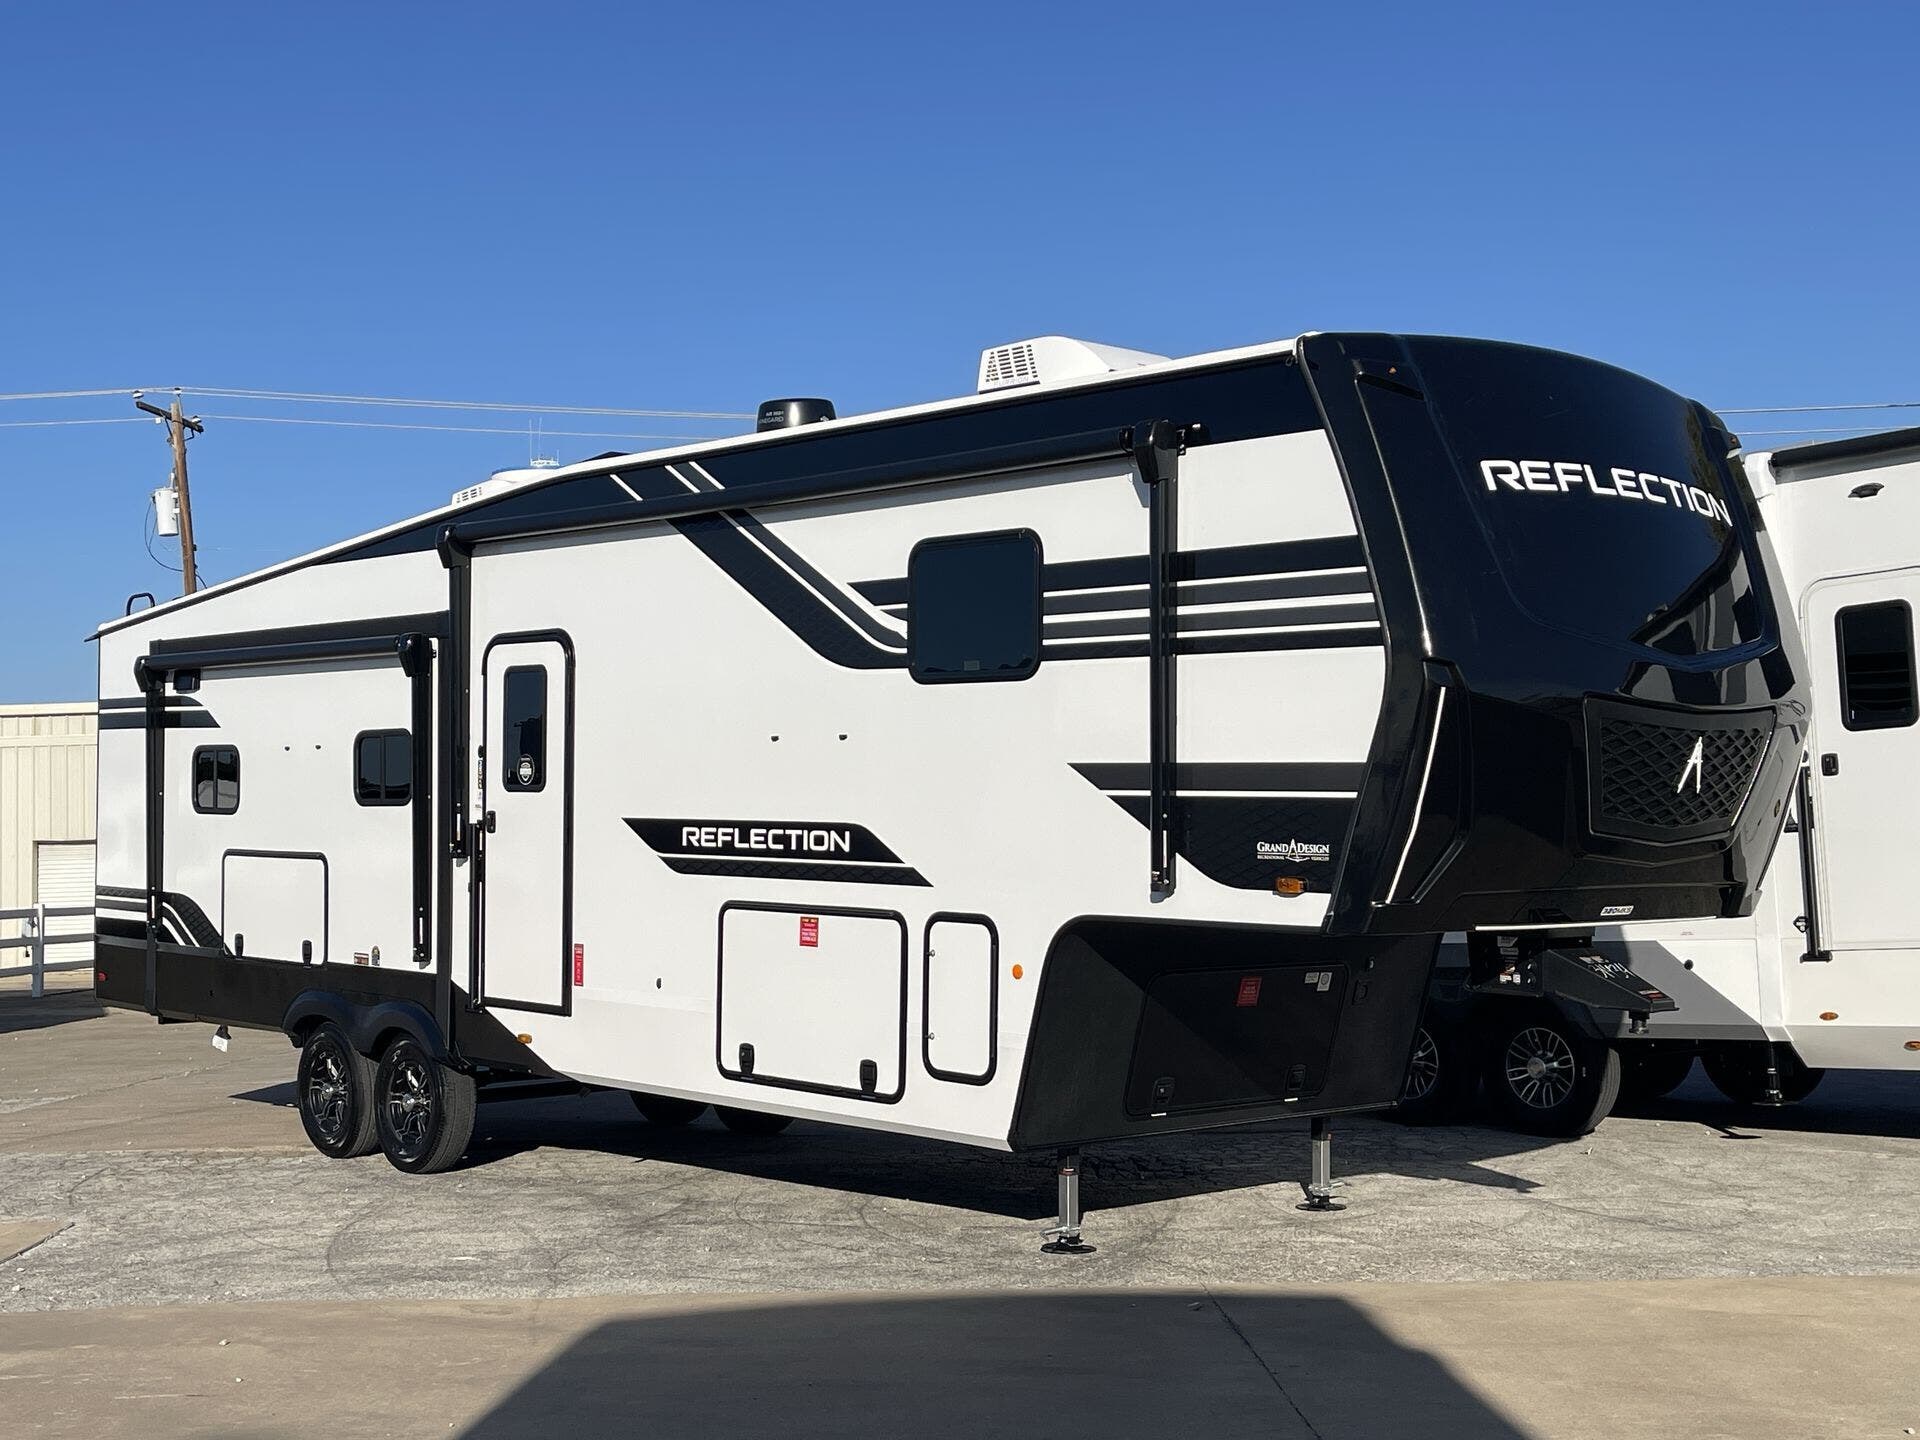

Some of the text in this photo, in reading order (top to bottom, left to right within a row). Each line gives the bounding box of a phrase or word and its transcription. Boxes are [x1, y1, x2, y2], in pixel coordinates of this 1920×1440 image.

[1479, 460, 1733, 527] REFLECTION
[681, 826, 850, 852] REFLECTION
[1256, 841, 1330, 854] GRAND DESIGN
